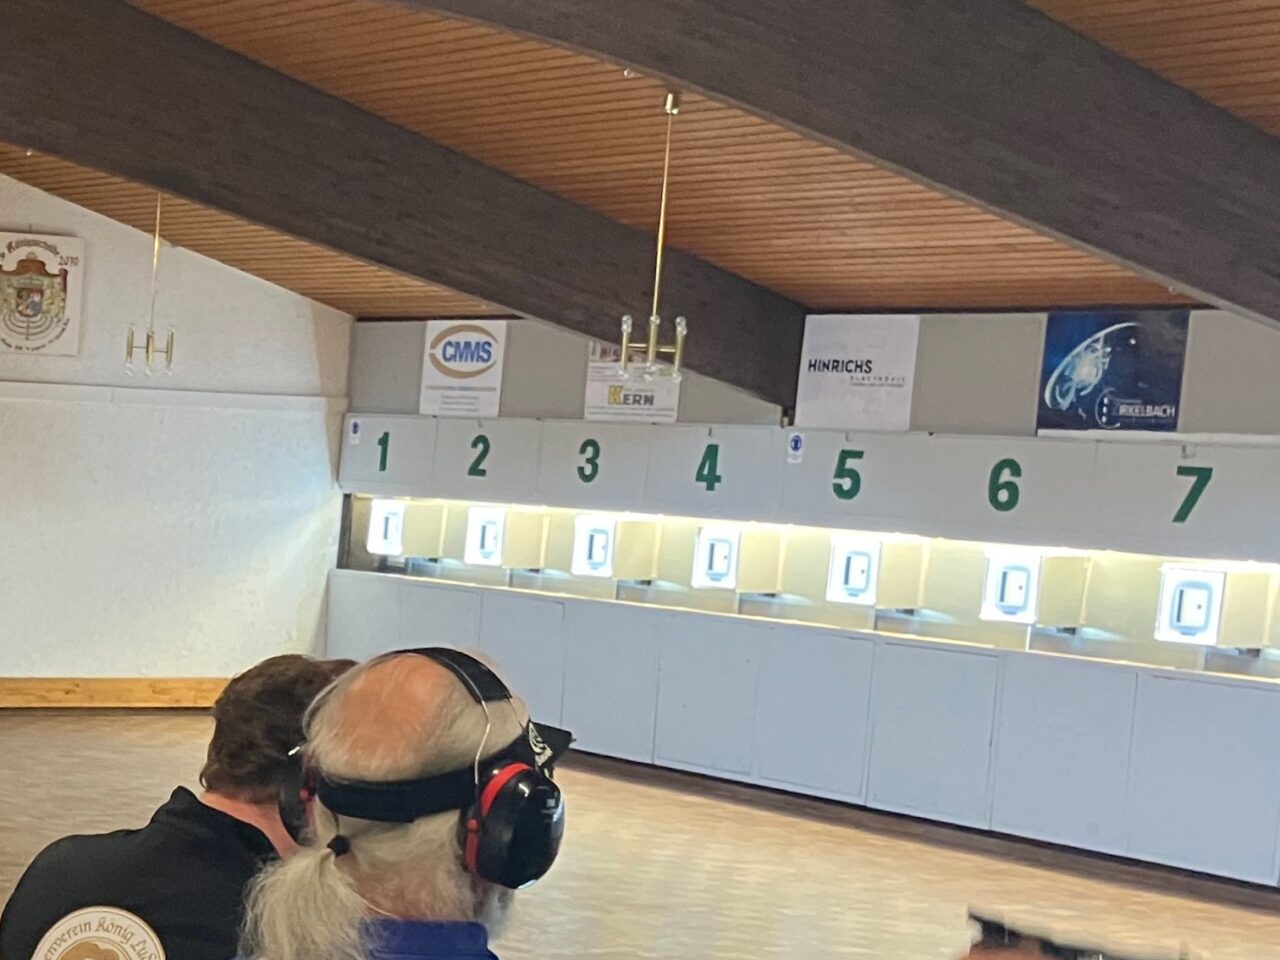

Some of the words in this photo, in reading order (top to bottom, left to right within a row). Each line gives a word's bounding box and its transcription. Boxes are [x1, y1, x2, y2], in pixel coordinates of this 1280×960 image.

[442, 341, 492, 363] CMMS
[808, 359, 872, 374] HINRICHS
[608, 385, 655, 406] KERN
[377, 431, 390, 472] 1
[467, 434, 491, 477] 2
[577, 438, 601, 483] 3
[695, 444, 722, 491] 4
[832, 449, 865, 500] 5
[988, 458, 1022, 512] 6
[1172, 466, 1213, 523] 7
[95, 917, 135, 944] König
